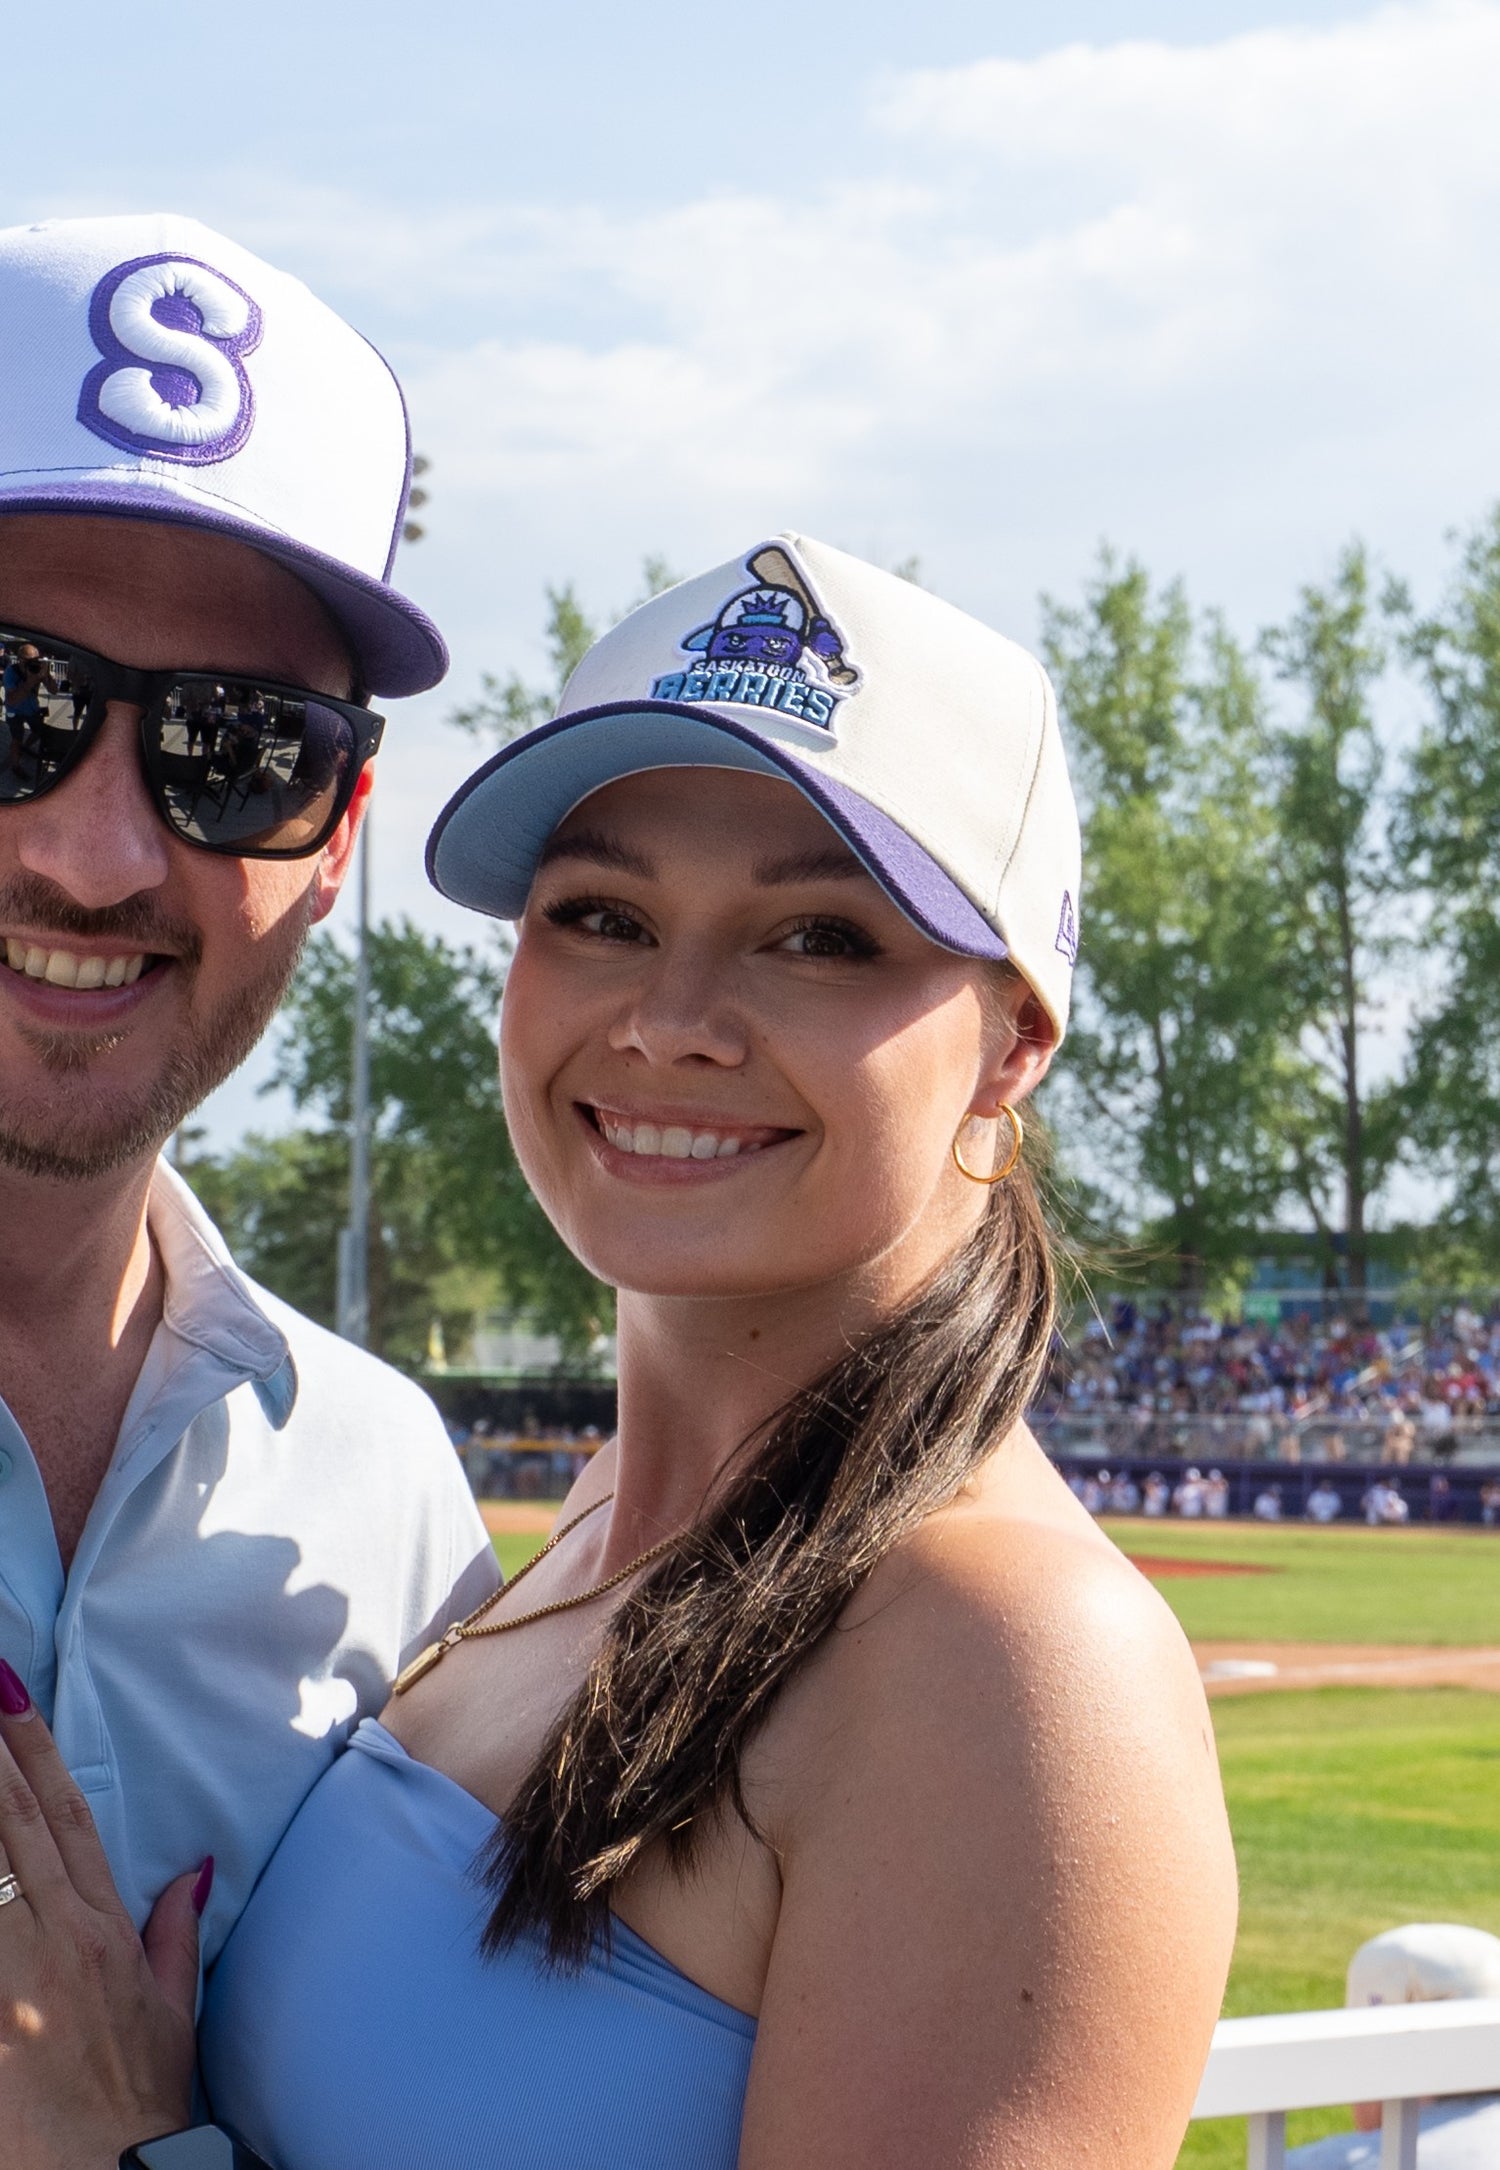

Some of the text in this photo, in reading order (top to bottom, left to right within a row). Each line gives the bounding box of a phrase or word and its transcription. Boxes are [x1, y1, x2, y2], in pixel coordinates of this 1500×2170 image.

[78, 253, 262, 466] S
[694, 660, 806, 683] SASKATOON
[654, 673, 833, 726] BERRIES
